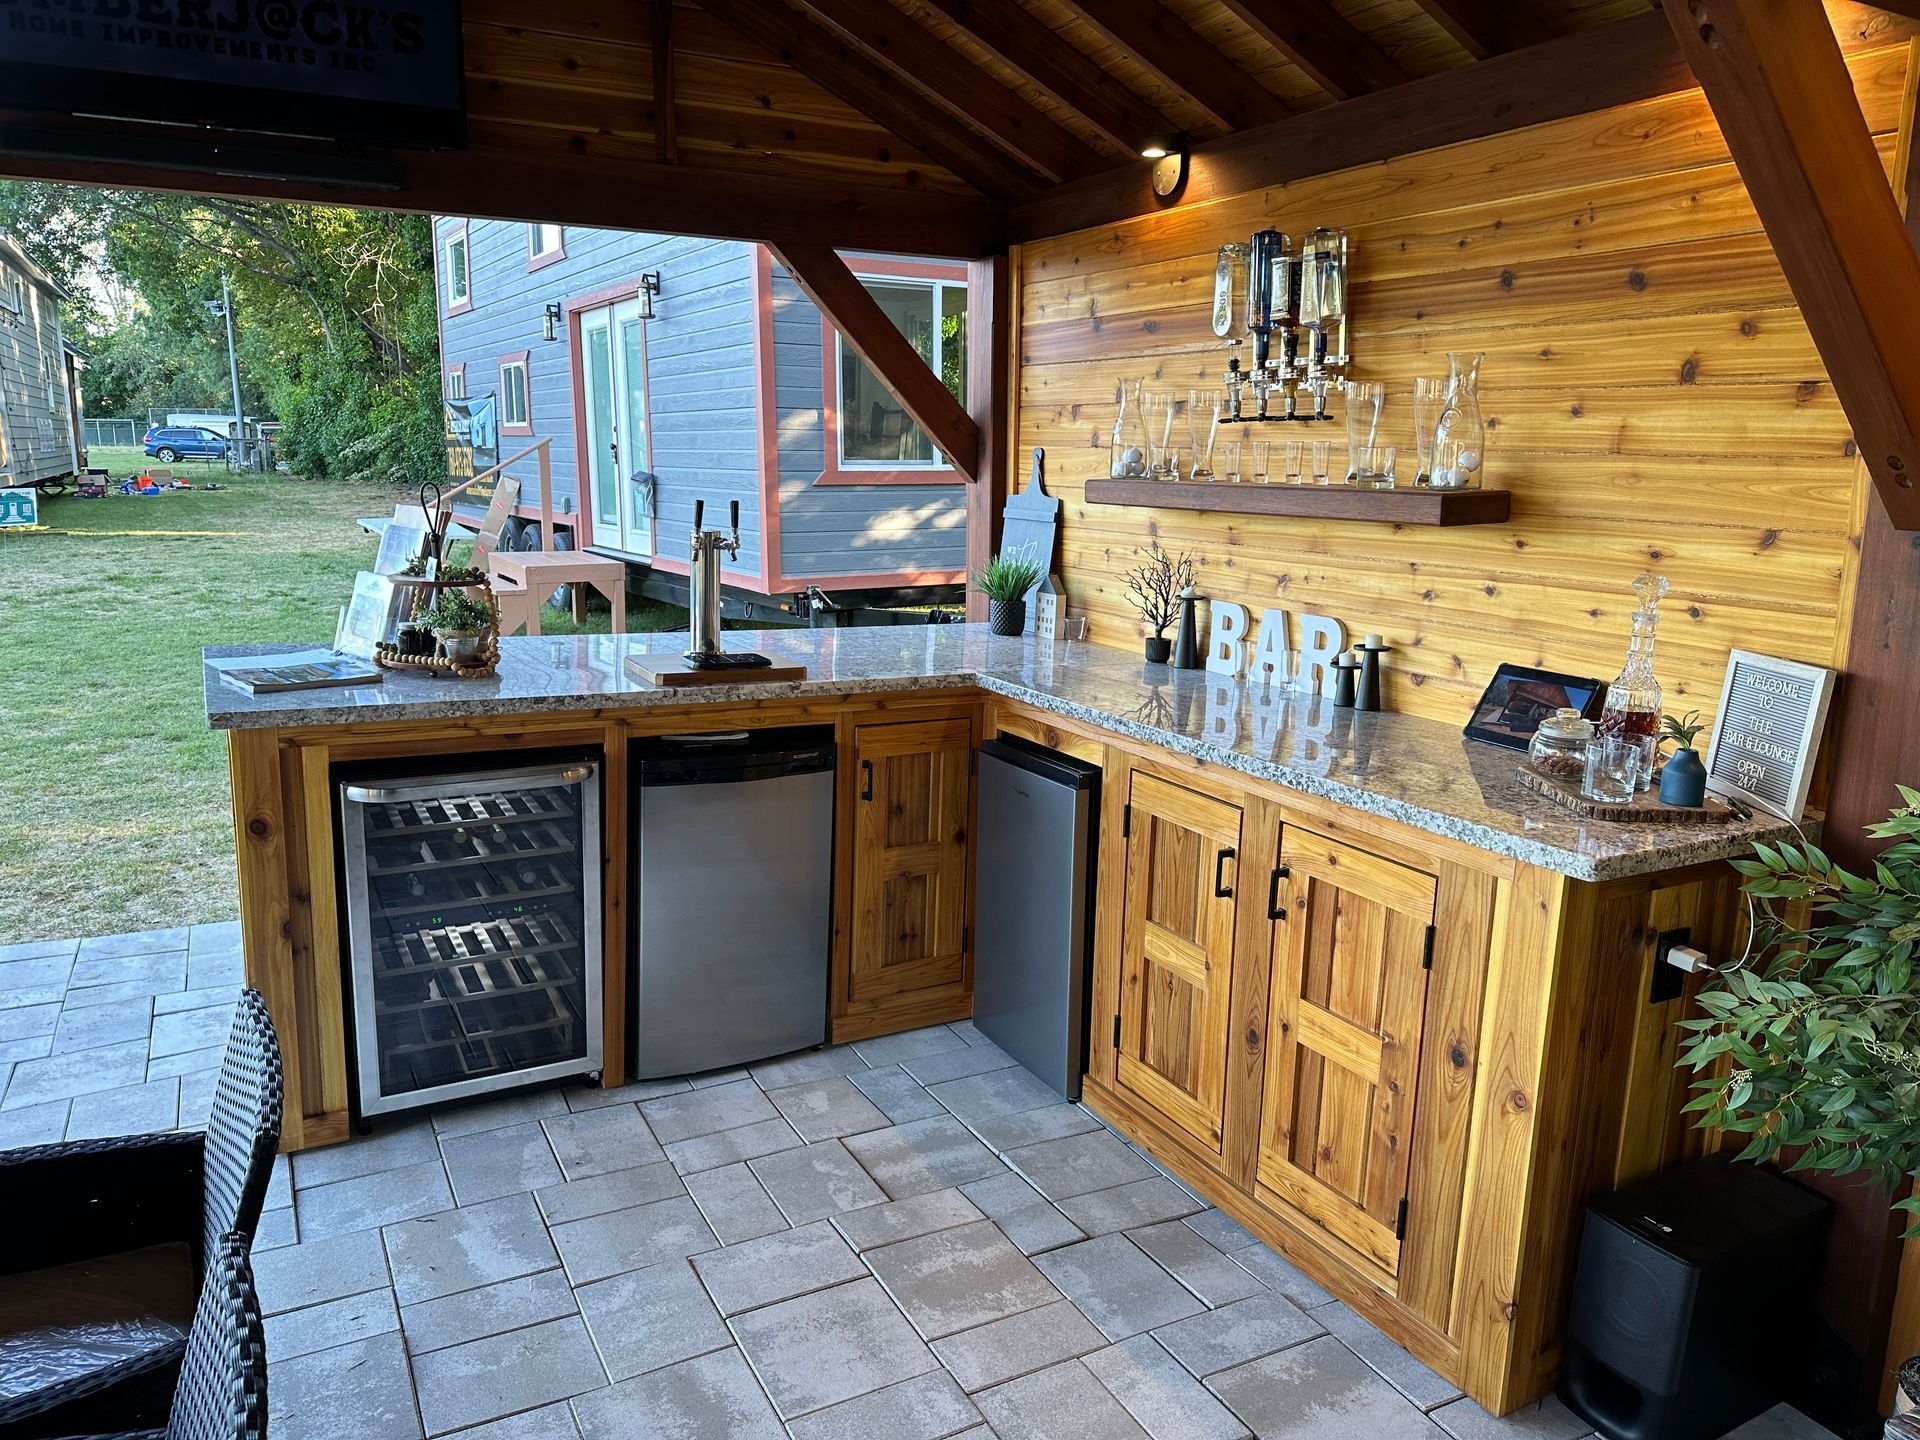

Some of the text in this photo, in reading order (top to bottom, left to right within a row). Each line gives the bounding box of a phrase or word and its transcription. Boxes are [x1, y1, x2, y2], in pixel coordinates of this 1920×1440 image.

[0, 0, 424, 55] ERJ@CK'S
[8, 11, 376, 72] HOME IMPROVEMENTS INC
[1205, 599, 1349, 699] BAR
[1746, 673, 1799, 698] WELCOME
[1759, 695, 1774, 709] TO
[1749, 716, 1773, 735] THE
[1726, 730, 1796, 764] BAR & LOUNGE
[1737, 760, 1766, 779] OPEN
[1737, 773, 1757, 791] 24/7
